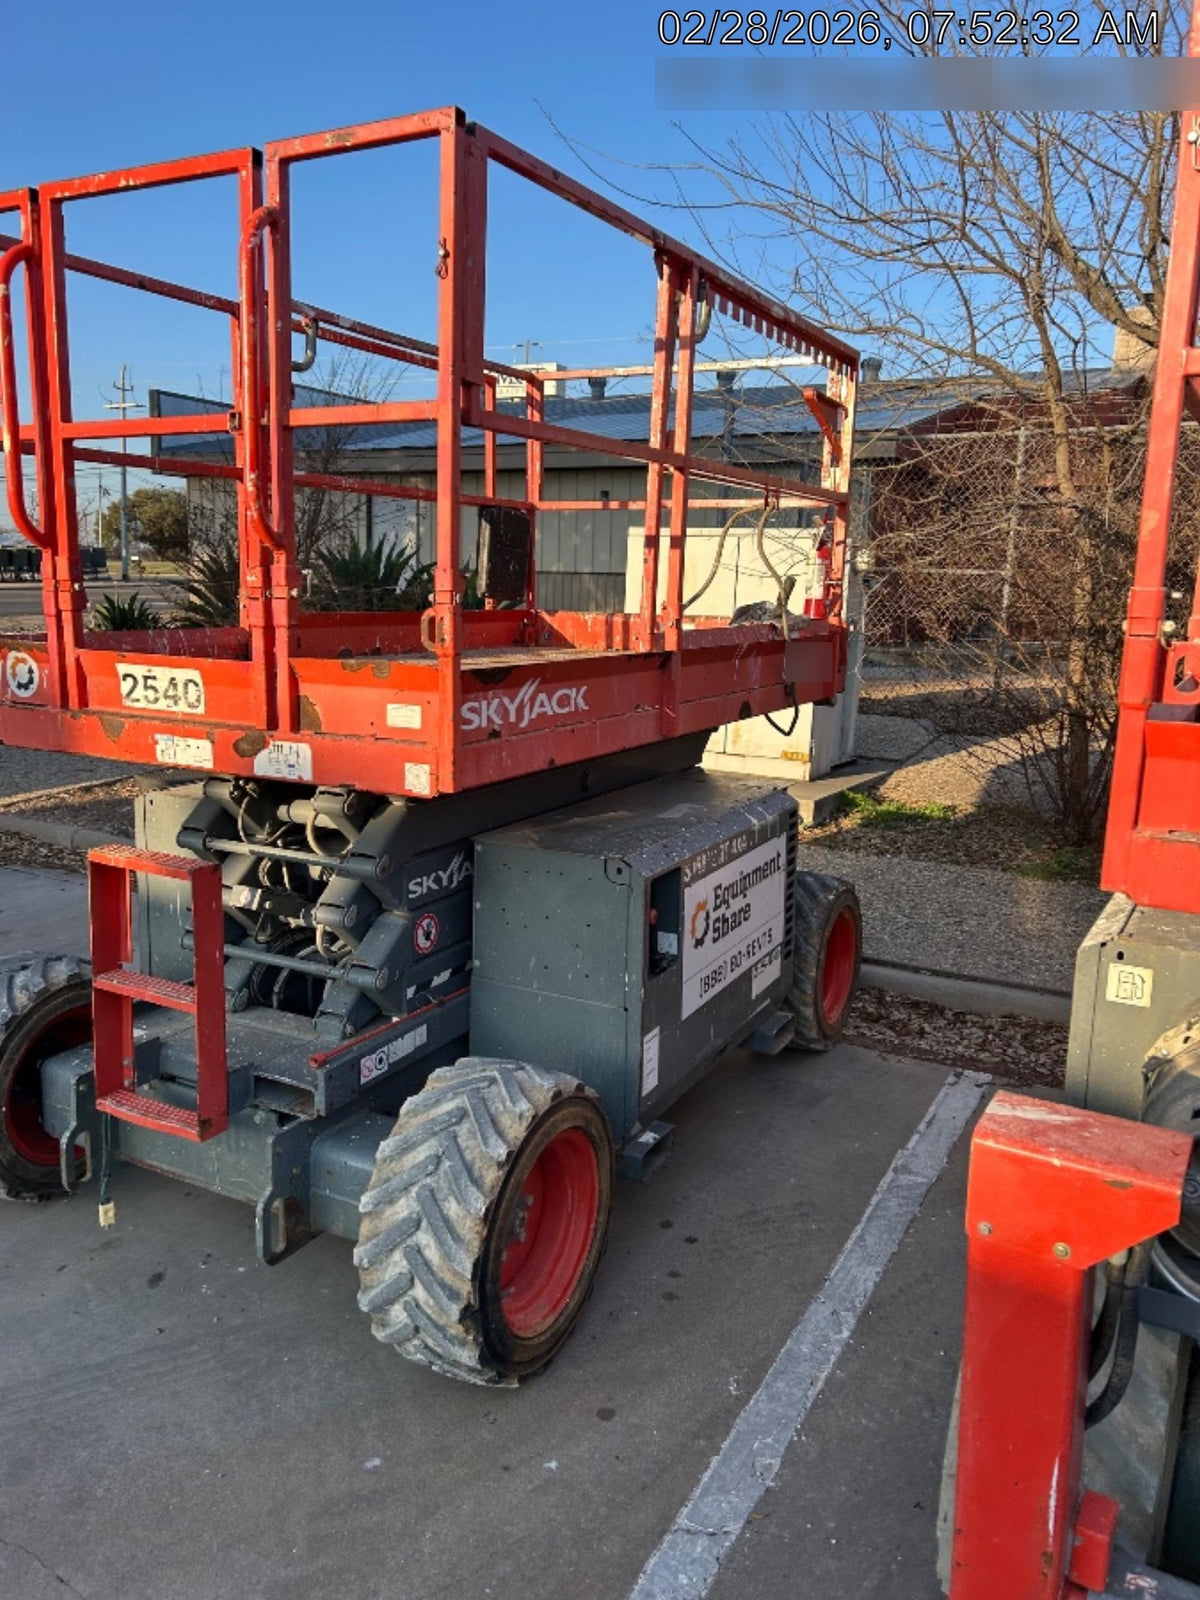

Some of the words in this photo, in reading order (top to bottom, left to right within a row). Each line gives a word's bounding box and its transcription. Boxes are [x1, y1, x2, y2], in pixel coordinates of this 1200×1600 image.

[122, 673, 201, 709] 2540
[460, 677, 589, 730] SKYJACK
[712, 850, 781, 912] Equipment
[712, 902, 751, 944] Share
